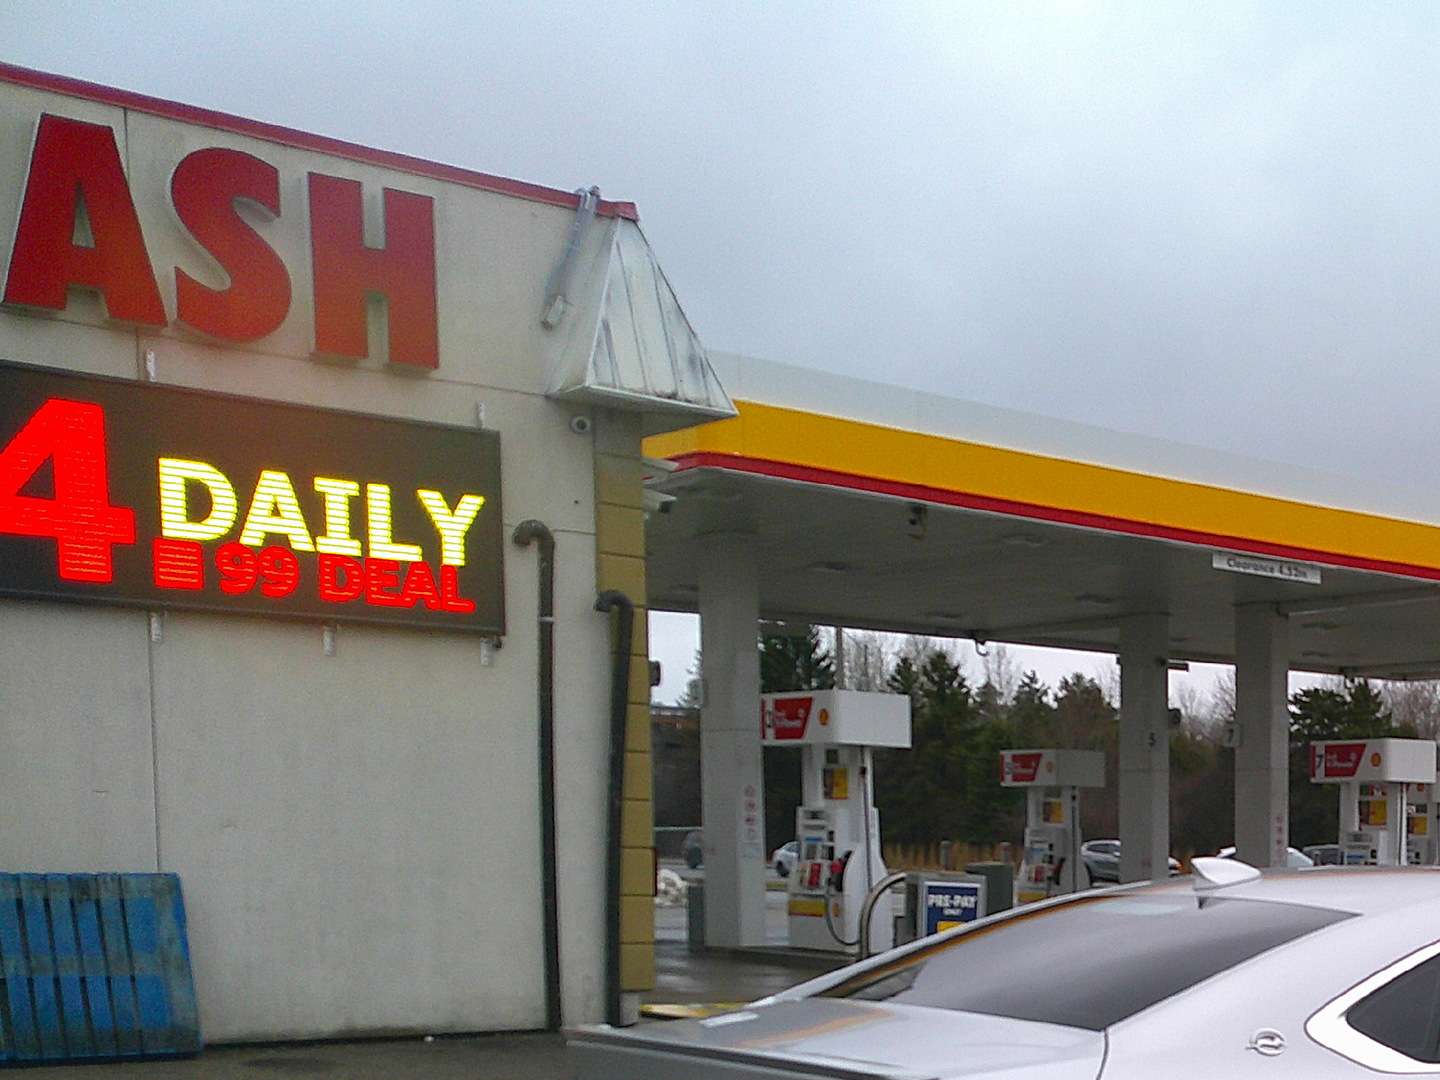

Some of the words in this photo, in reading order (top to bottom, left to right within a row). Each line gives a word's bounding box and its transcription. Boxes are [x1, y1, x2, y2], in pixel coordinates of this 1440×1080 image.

[4, 112, 440, 369] ASH
[158, 456, 486, 567] DAILY
[318, 552, 477, 614] DEAL
